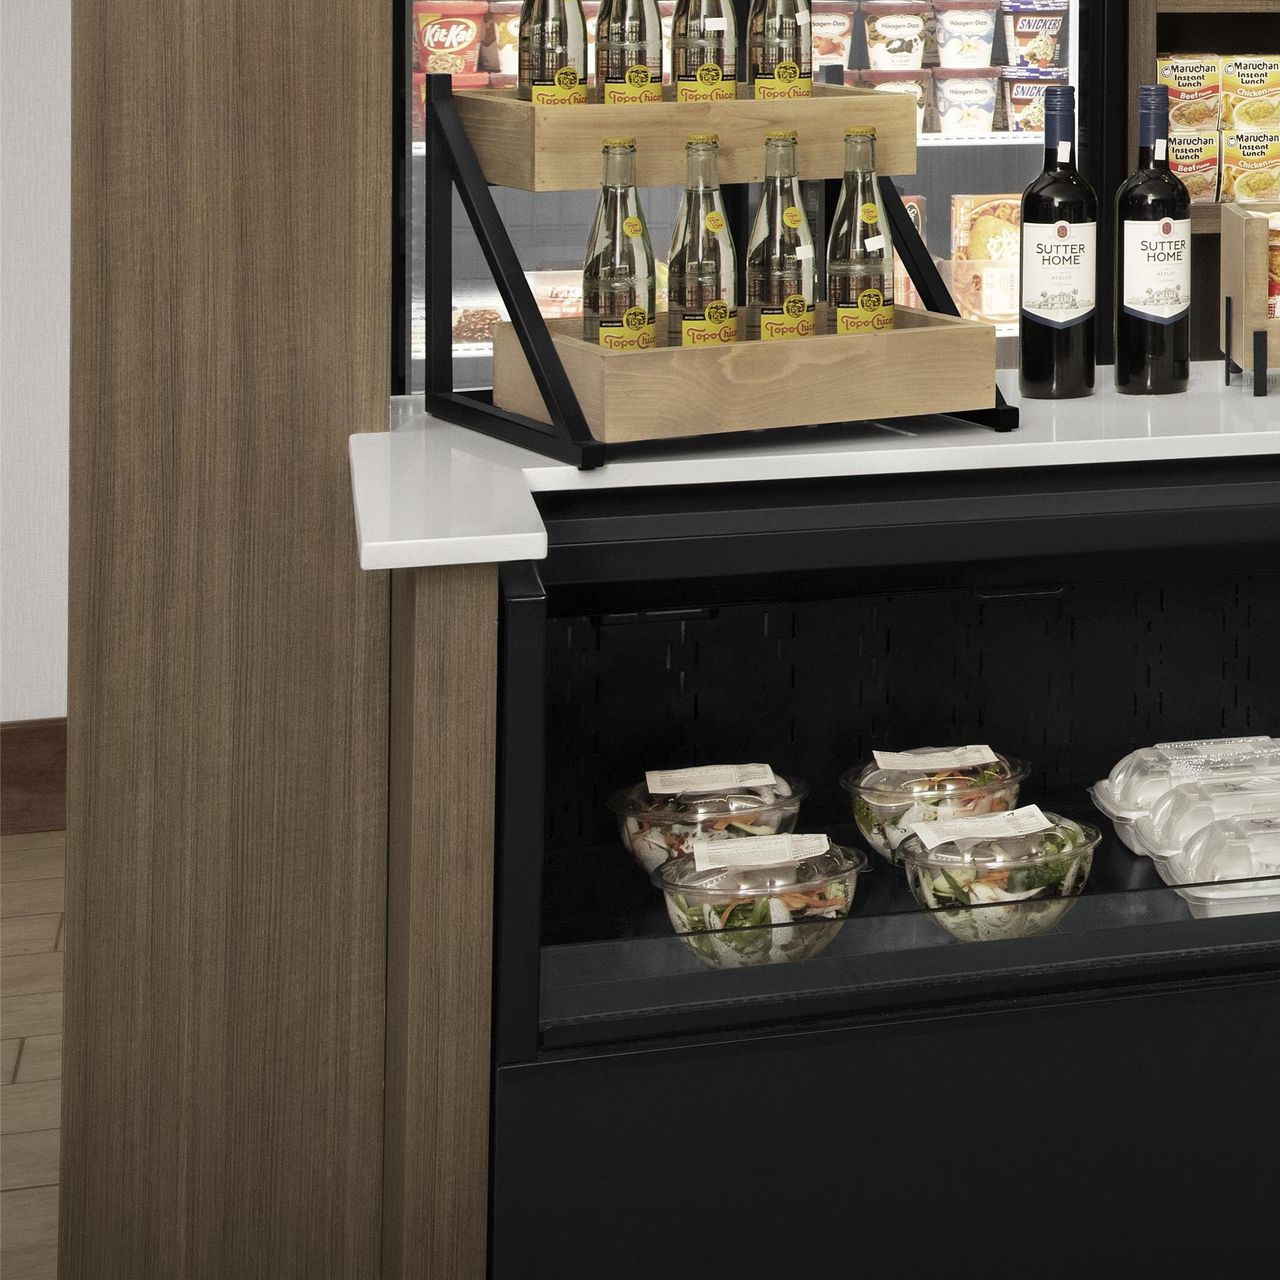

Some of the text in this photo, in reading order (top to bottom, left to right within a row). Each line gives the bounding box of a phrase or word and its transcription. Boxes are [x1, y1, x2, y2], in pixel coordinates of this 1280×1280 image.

[1018, 18, 1063, 31] SNICKERS
[1171, 64, 1216, 73] Maruchan
[1234, 61, 1279, 71] Maruchan
[1174, 74, 1205, 82] Instant
[1237, 71, 1268, 79] Instant
[1177, 80, 1202, 88] Lunch
[1241, 77, 1265, 85] Lunch
[680, 88, 712, 102] Topo
[758, 86, 789, 100] Topo
[1179, 91, 1198, 100] Beef
[1237, 87, 1267, 96] Chicken
[1168, 137, 1214, 146] Maruchan
[1235, 134, 1280, 143] Maruchan
[1239, 144, 1269, 152] Instant
[1175, 152, 1200, 160] Lunch
[1242, 149, 1266, 157] Lunch
[1177, 164, 1196, 172] Beef
[1238, 159, 1268, 169] Chicken
[1036, 243, 1085, 255] SUTTER
[1140, 240, 1186, 252] SUTTER
[1042, 255, 1081, 266] HOME
[1147, 251, 1183, 262] HOME
[841, 315, 873, 331] Topo
